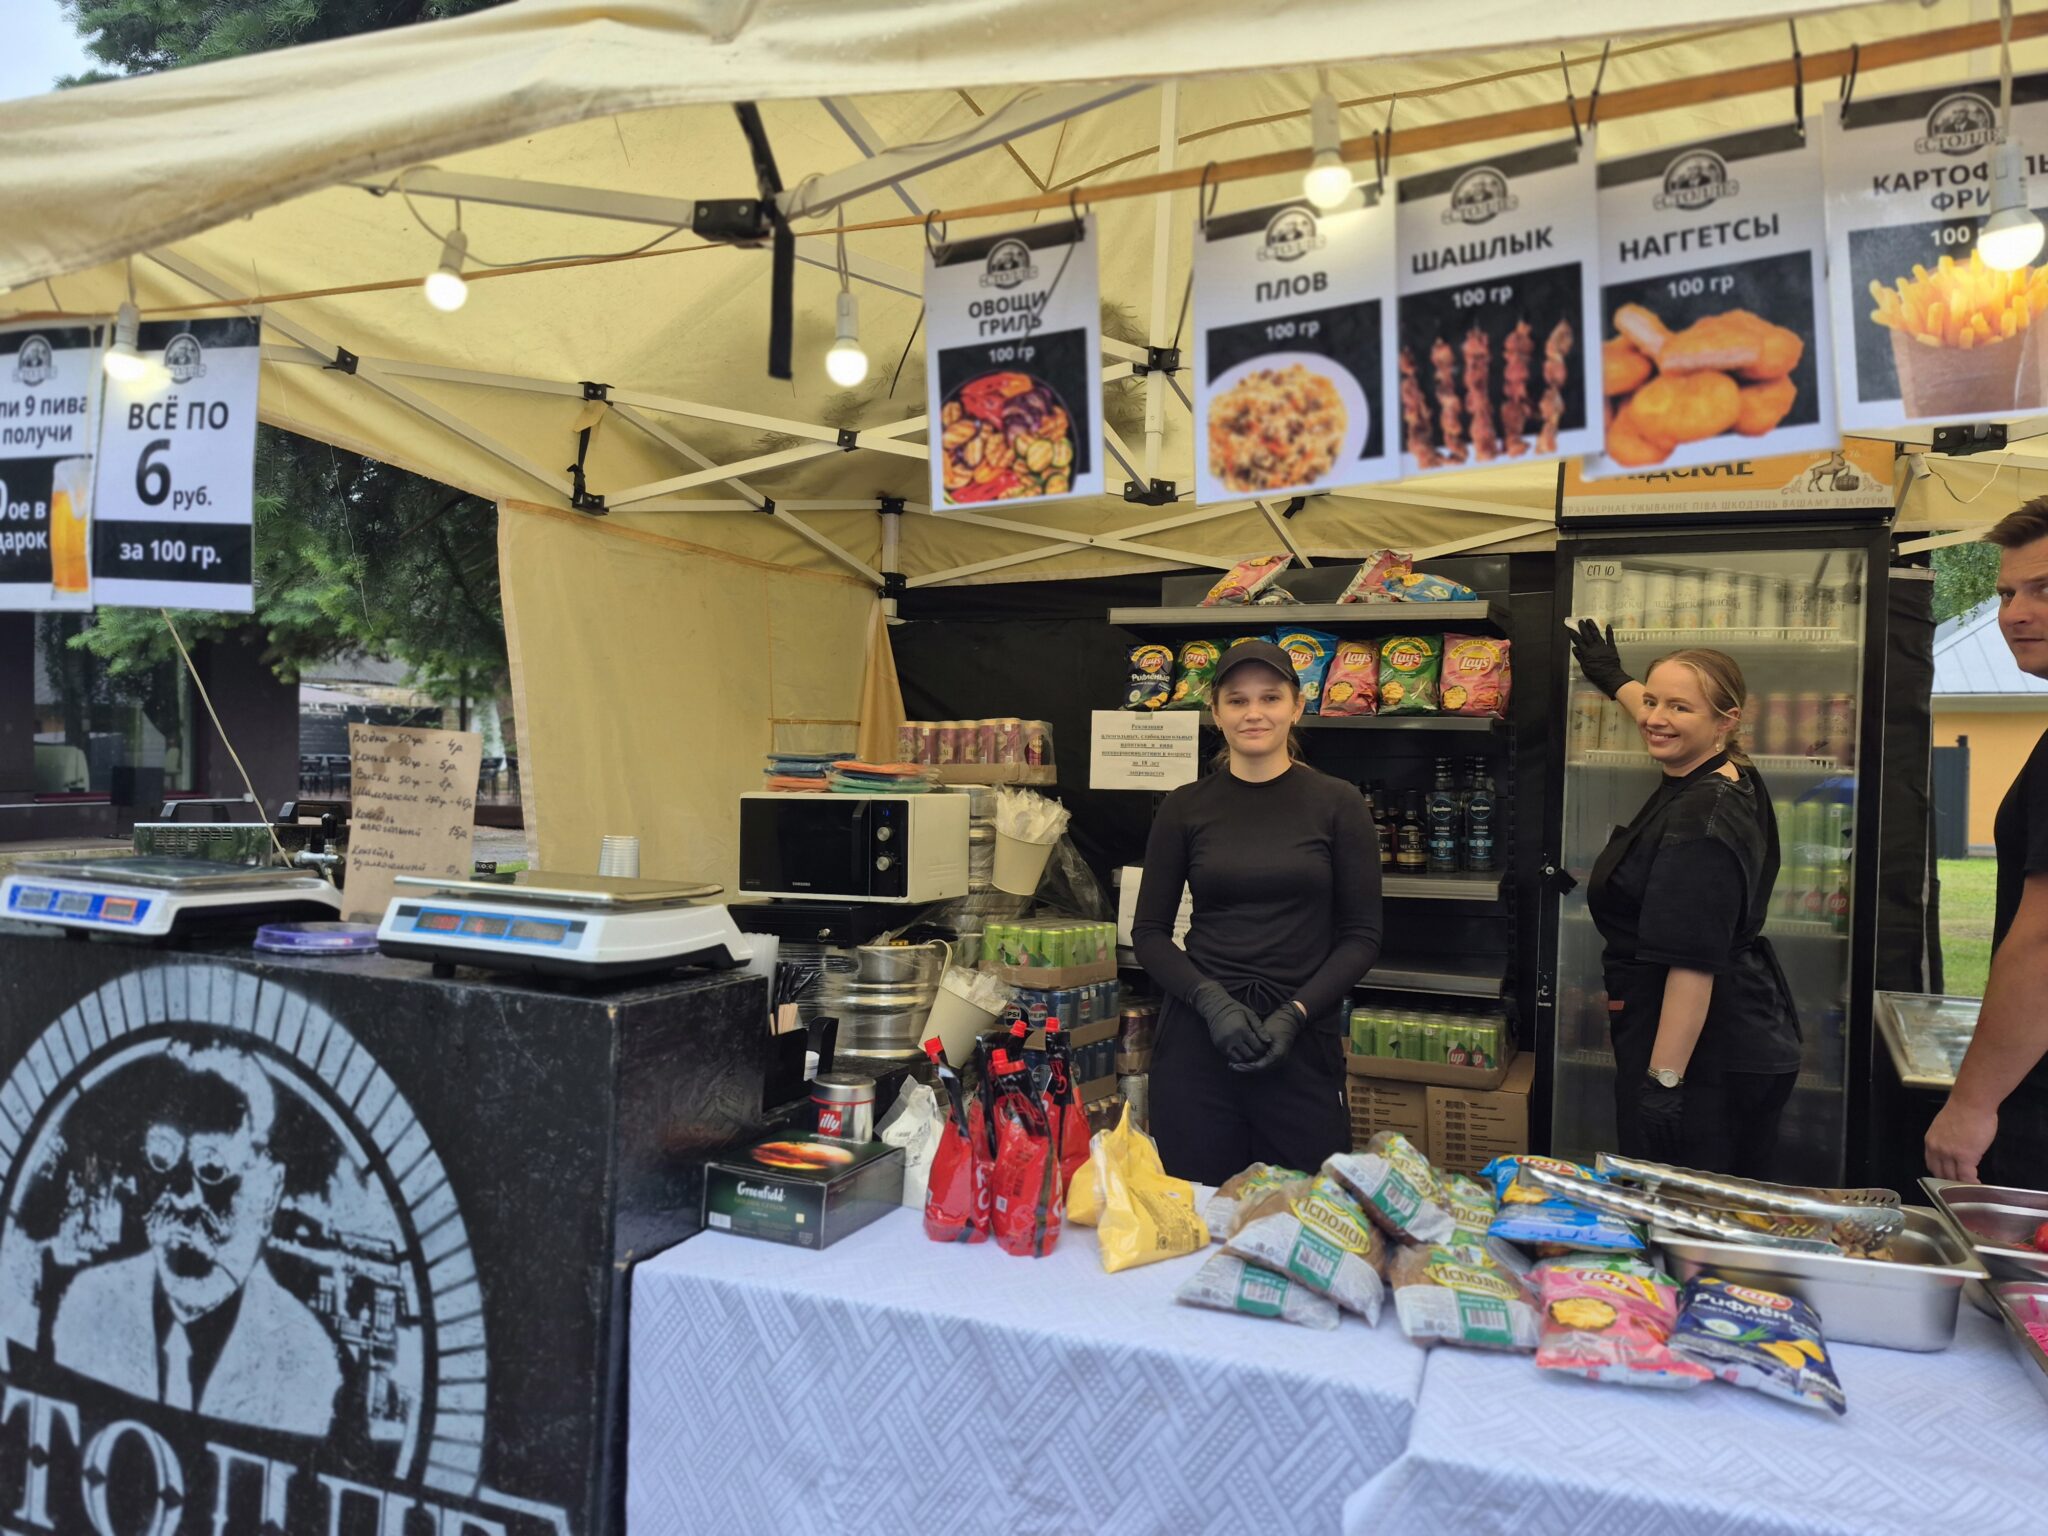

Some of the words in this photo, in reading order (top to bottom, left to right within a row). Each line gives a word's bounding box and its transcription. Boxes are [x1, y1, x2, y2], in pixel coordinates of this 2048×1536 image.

[1619, 213, 1780, 264] НАГГЕТСЫ
[1931, 225, 1971, 247] 100
[1411, 226, 1554, 275] ШАШЛЫК
[1255, 271, 1329, 302] ПЛОВ
[1452, 289, 1486, 309] 100
[1490, 285, 1514, 304] гр
[1667, 278, 1704, 298] 100
[1710, 274, 1735, 294] гр
[968, 290, 1049, 319] ОВОЩИ
[979, 313, 1043, 338] ГРИЛЬ
[1265, 323, 1297, 341] 100
[1298, 321, 1321, 339] гр
[989, 346, 1015, 363] 100
[1016, 346, 1036, 363] гр
[25, 395, 36, 417] 9
[40, 396, 87, 416] пива
[128, 396, 179, 431] ВСЁ
[187, 401, 230, 431] ПО
[2, 424, 73, 449] получи
[135, 438, 172, 506] 6
[173, 486, 213, 511] руб.
[119, 542, 144, 561] за
[150, 540, 187, 562] 100
[191, 543, 222, 569] гр.
[819, 1113, 840, 1132] illy
[736, 1181, 785, 1202] Greenfield
